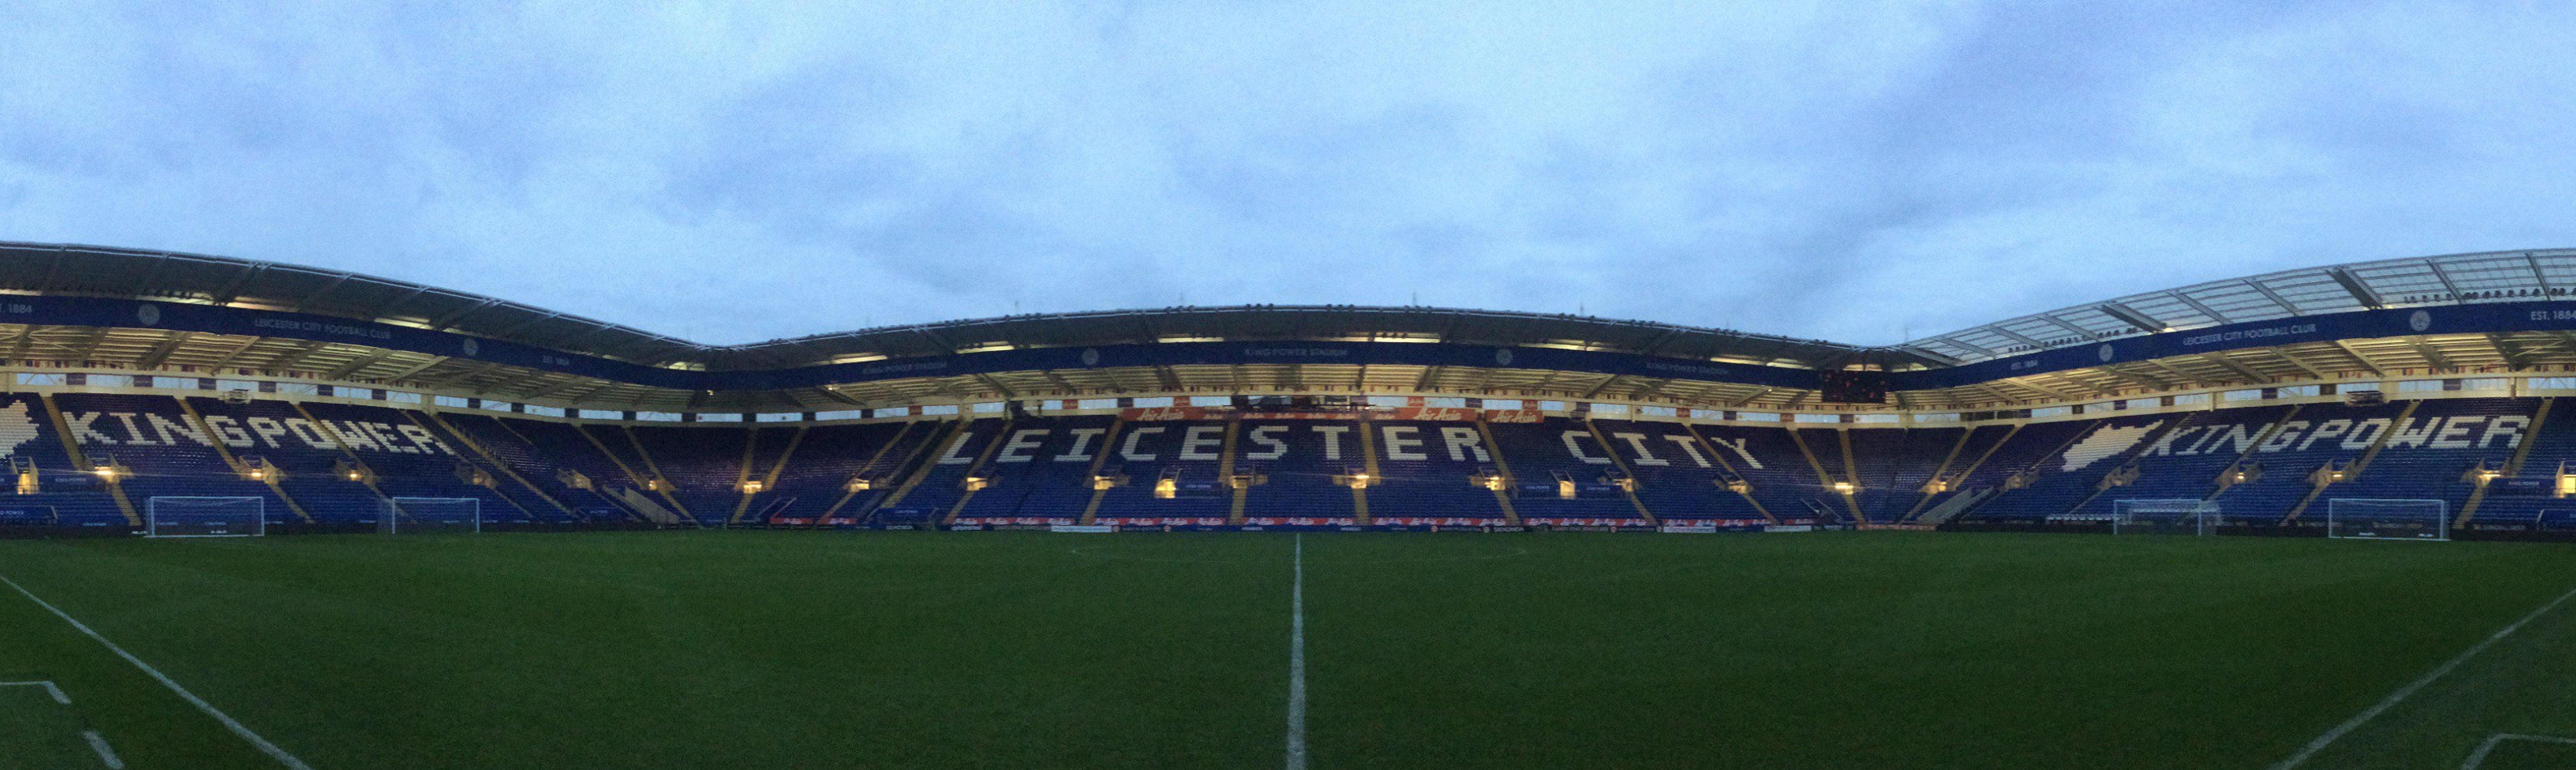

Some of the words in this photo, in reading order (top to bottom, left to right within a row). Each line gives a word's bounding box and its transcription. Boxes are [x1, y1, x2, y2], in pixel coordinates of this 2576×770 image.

[8, 303, 32, 313] 1884
[2530, 311, 2550, 320] EST.
[2244, 326, 2289, 338] FOOTBALL
[2290, 323, 2316, 334] CLUB
[936, 426, 1491, 465] LEICESTER
[1560, 430, 1764, 470] CITY
